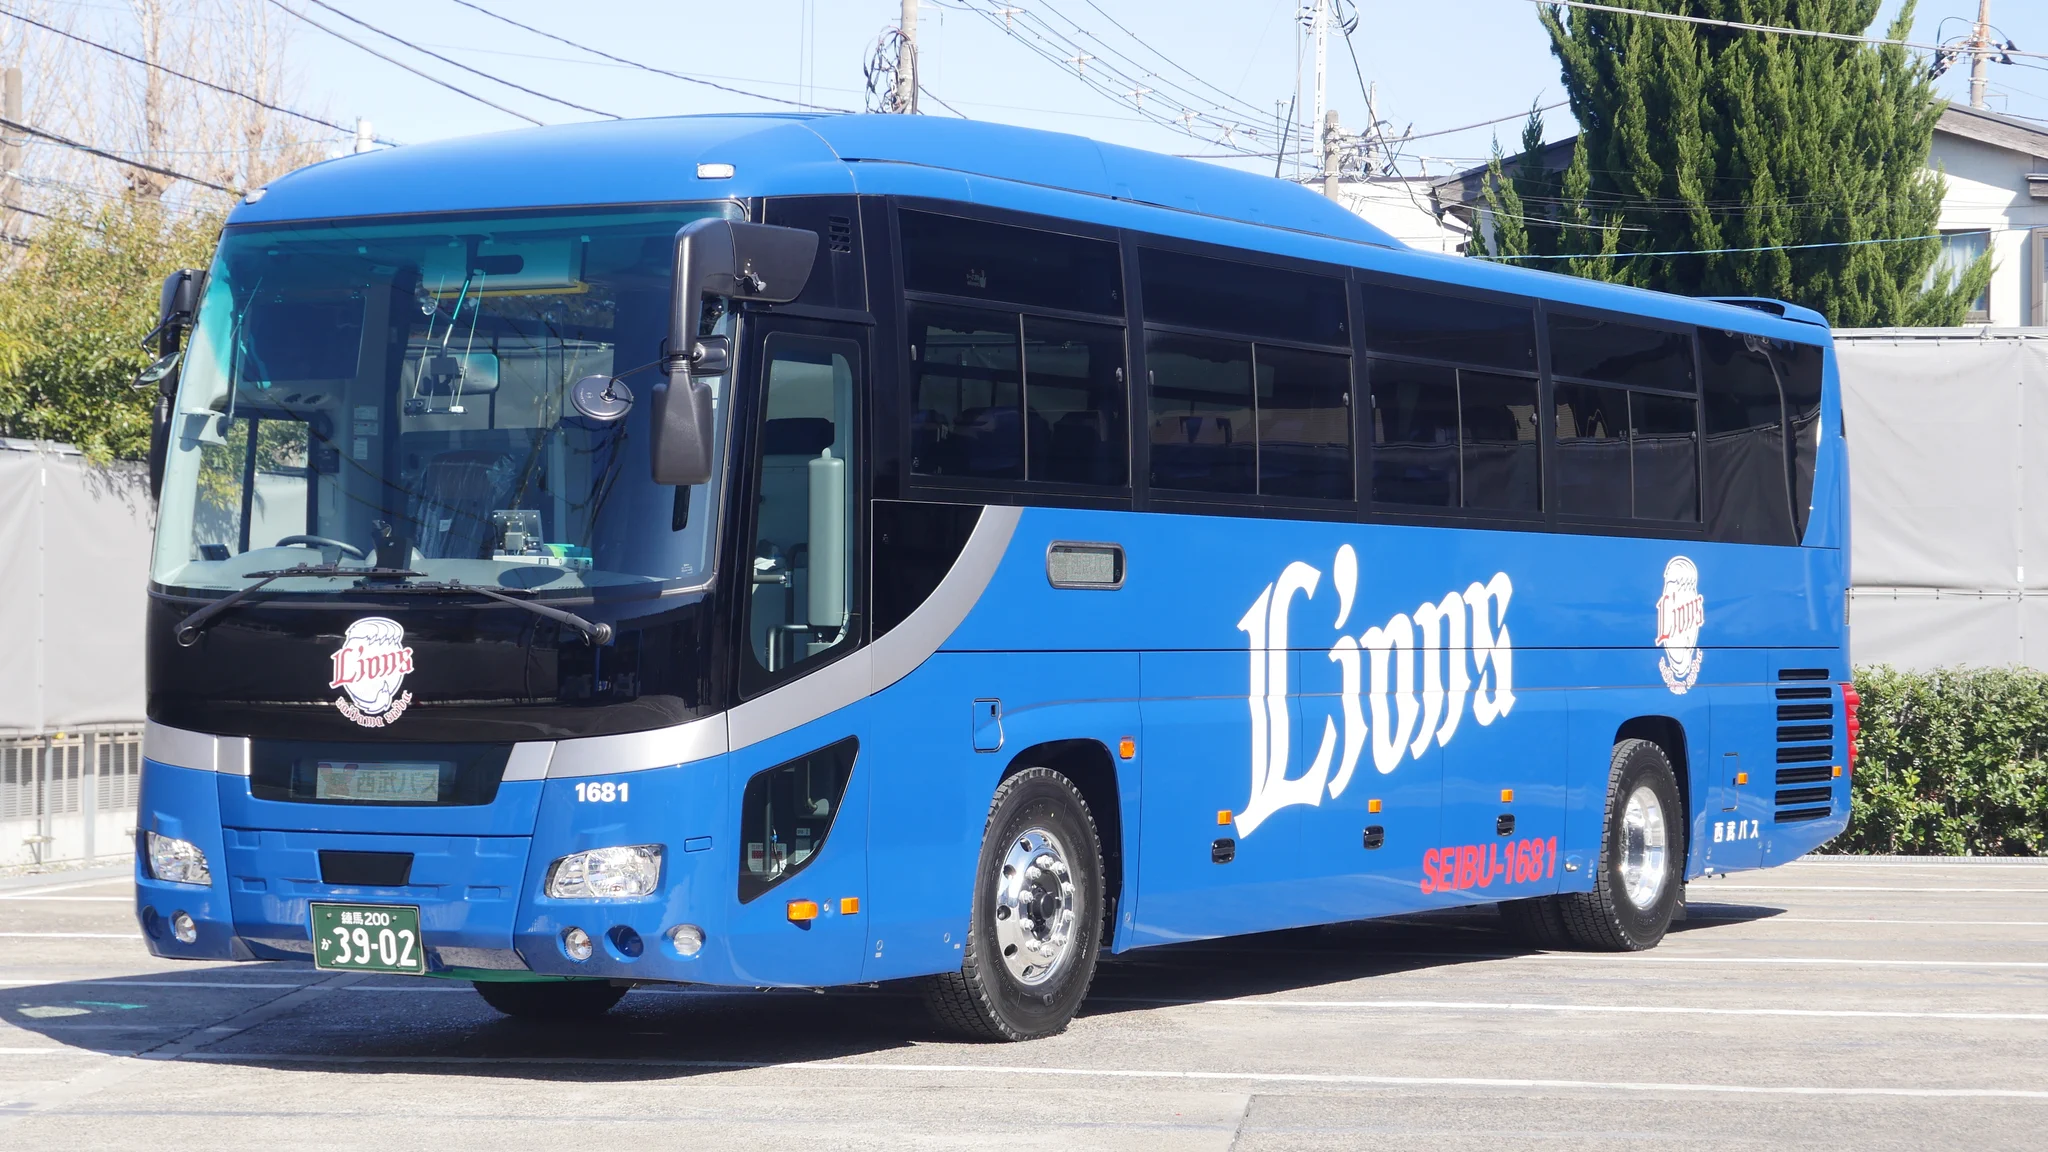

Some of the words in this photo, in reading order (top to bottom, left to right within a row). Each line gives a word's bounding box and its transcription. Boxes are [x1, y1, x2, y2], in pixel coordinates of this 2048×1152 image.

[1656, 592, 1704, 644] Lions
[331, 645, 413, 687] Lions
[1234, 543, 1516, 839] Lions
[575, 782, 629, 803] 1681
[1713, 820, 1759, 843] 西武バス
[1420, 836, 1557, 895] SEIBU-1681
[321, 938, 332, 951] か
[333, 927, 416, 966] 39-02
